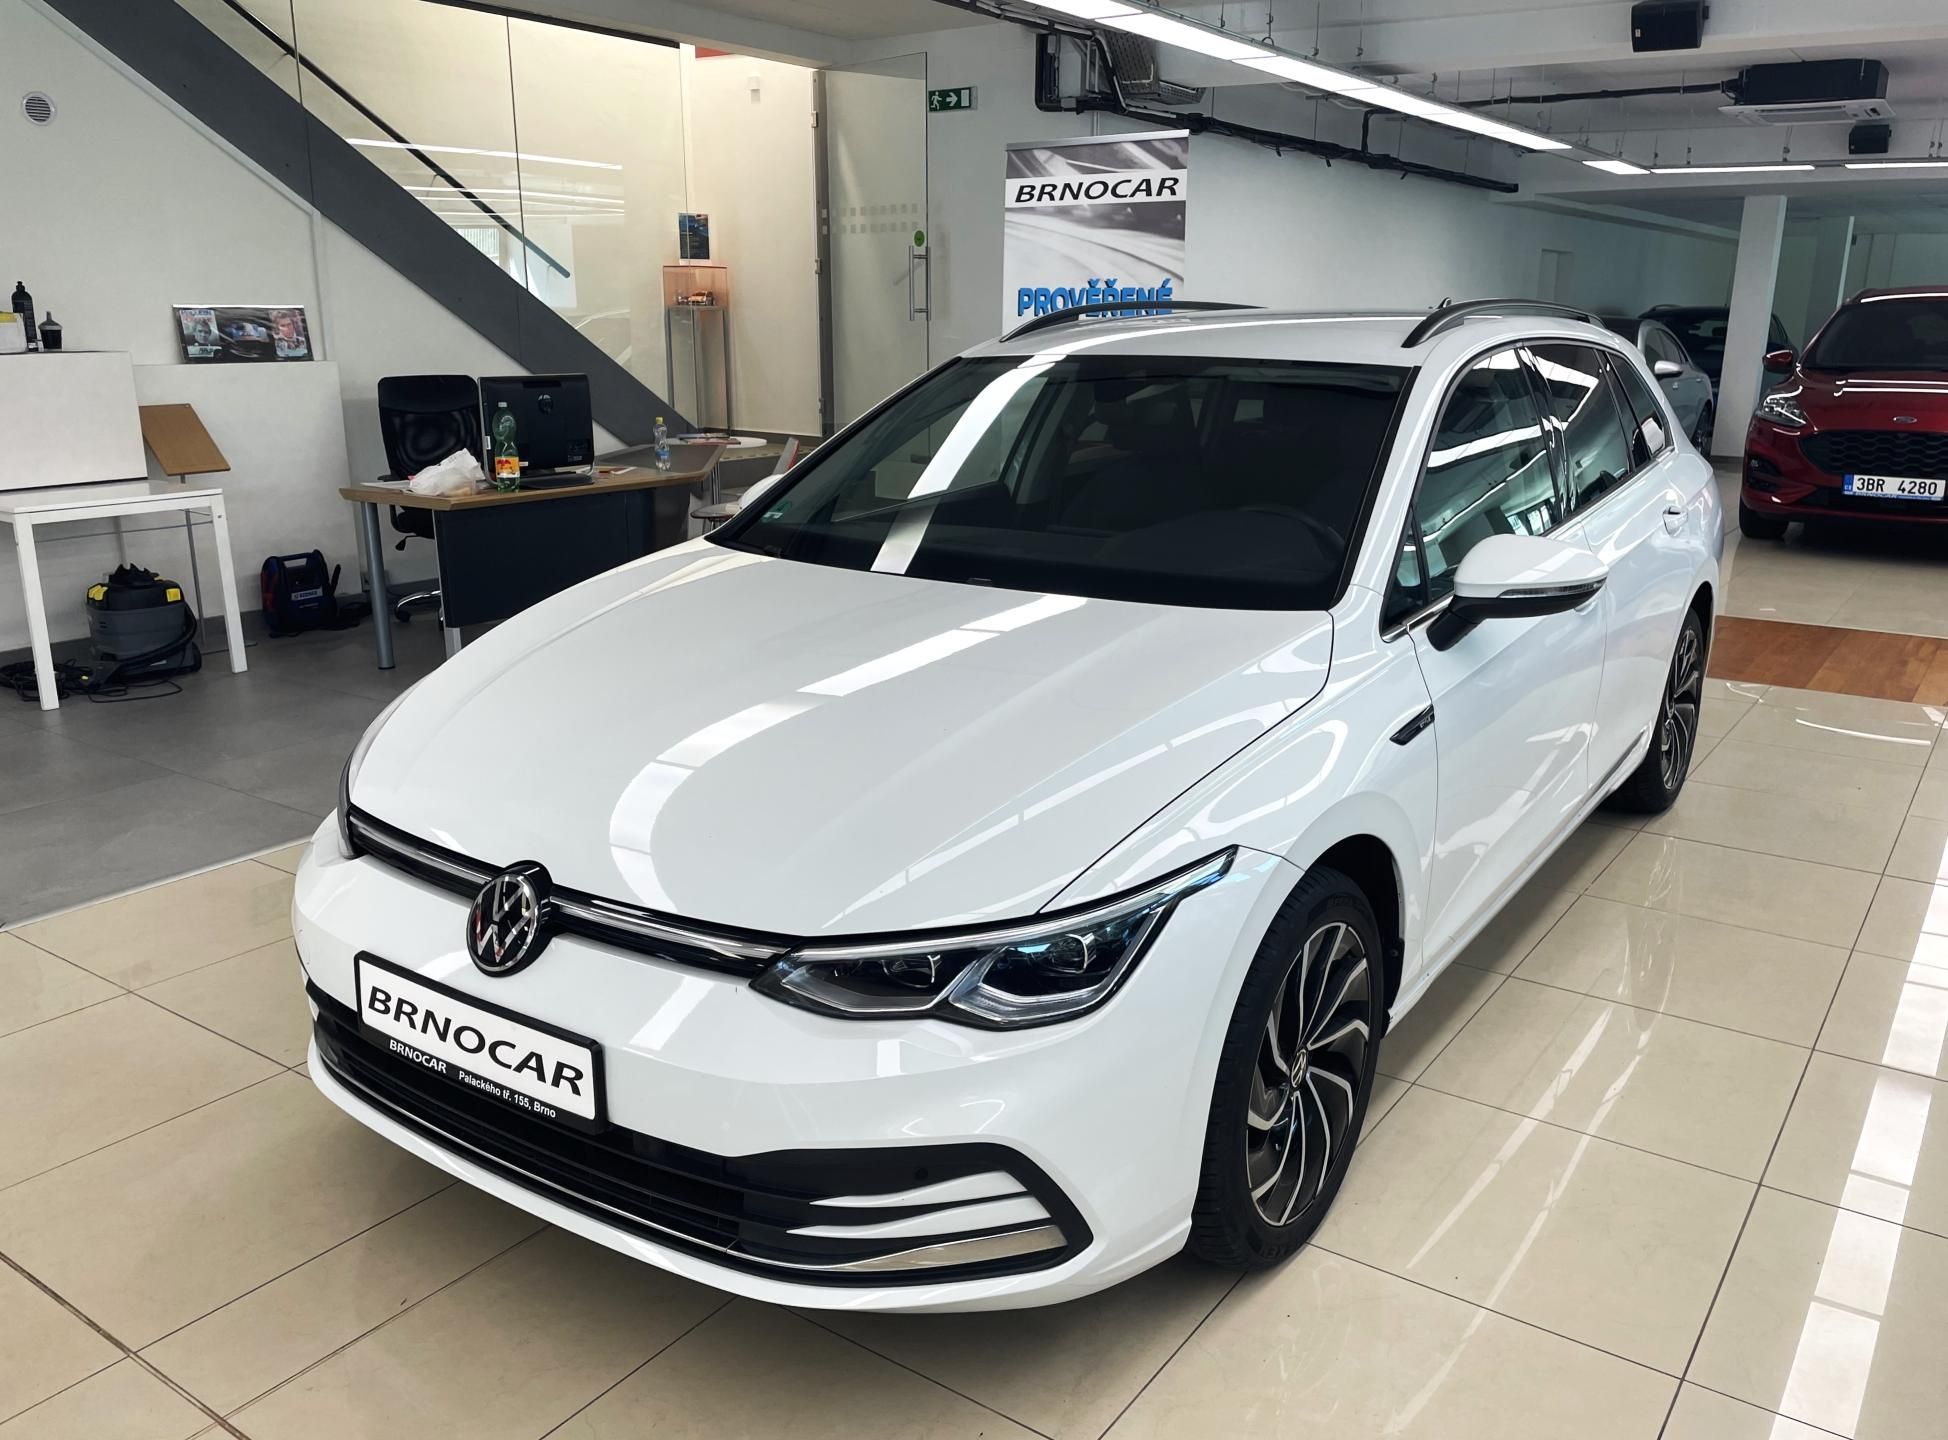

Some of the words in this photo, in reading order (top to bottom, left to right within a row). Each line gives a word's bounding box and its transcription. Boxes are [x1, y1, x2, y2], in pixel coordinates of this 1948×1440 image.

[1014, 177, 1180, 203] BRNOCAR
[1856, 477, 1886, 493] 3BR
[1897, 480, 1938, 496] 4280
[368, 985, 584, 1097] BRNOCAR
[389, 1039, 447, 1074] BRNOCAR
[458, 1071, 501, 1096] Palackého
[503, 1089, 512, 1101] tř.
[514, 1094, 531, 1110] 155,
[533, 1101, 556, 1118] Brno
